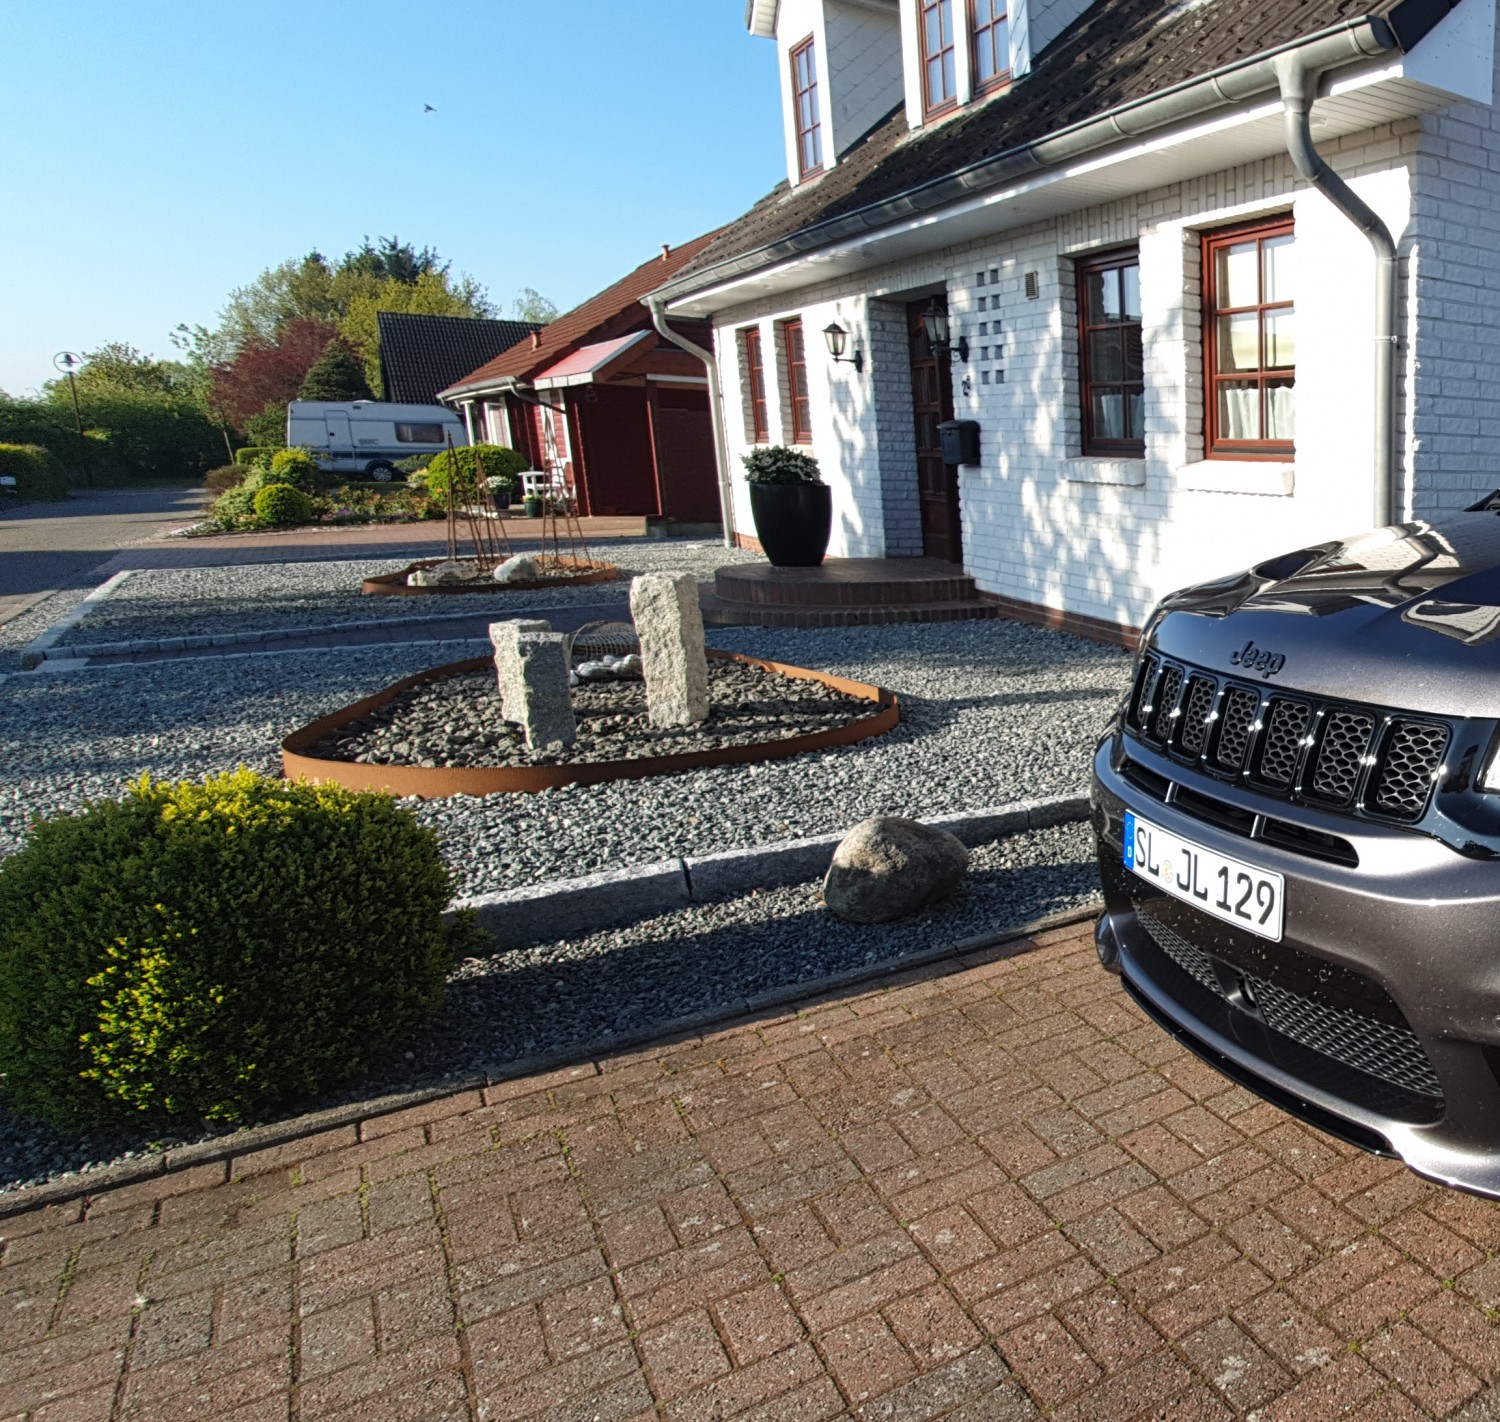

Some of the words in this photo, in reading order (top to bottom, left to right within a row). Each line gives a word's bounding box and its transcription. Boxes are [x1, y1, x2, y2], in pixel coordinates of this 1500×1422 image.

[1229, 640, 1286, 679] Jeep
[1135, 827, 1160, 877] SL
[1176, 848, 1208, 901] JL
[1215, 865, 1275, 926] 129
